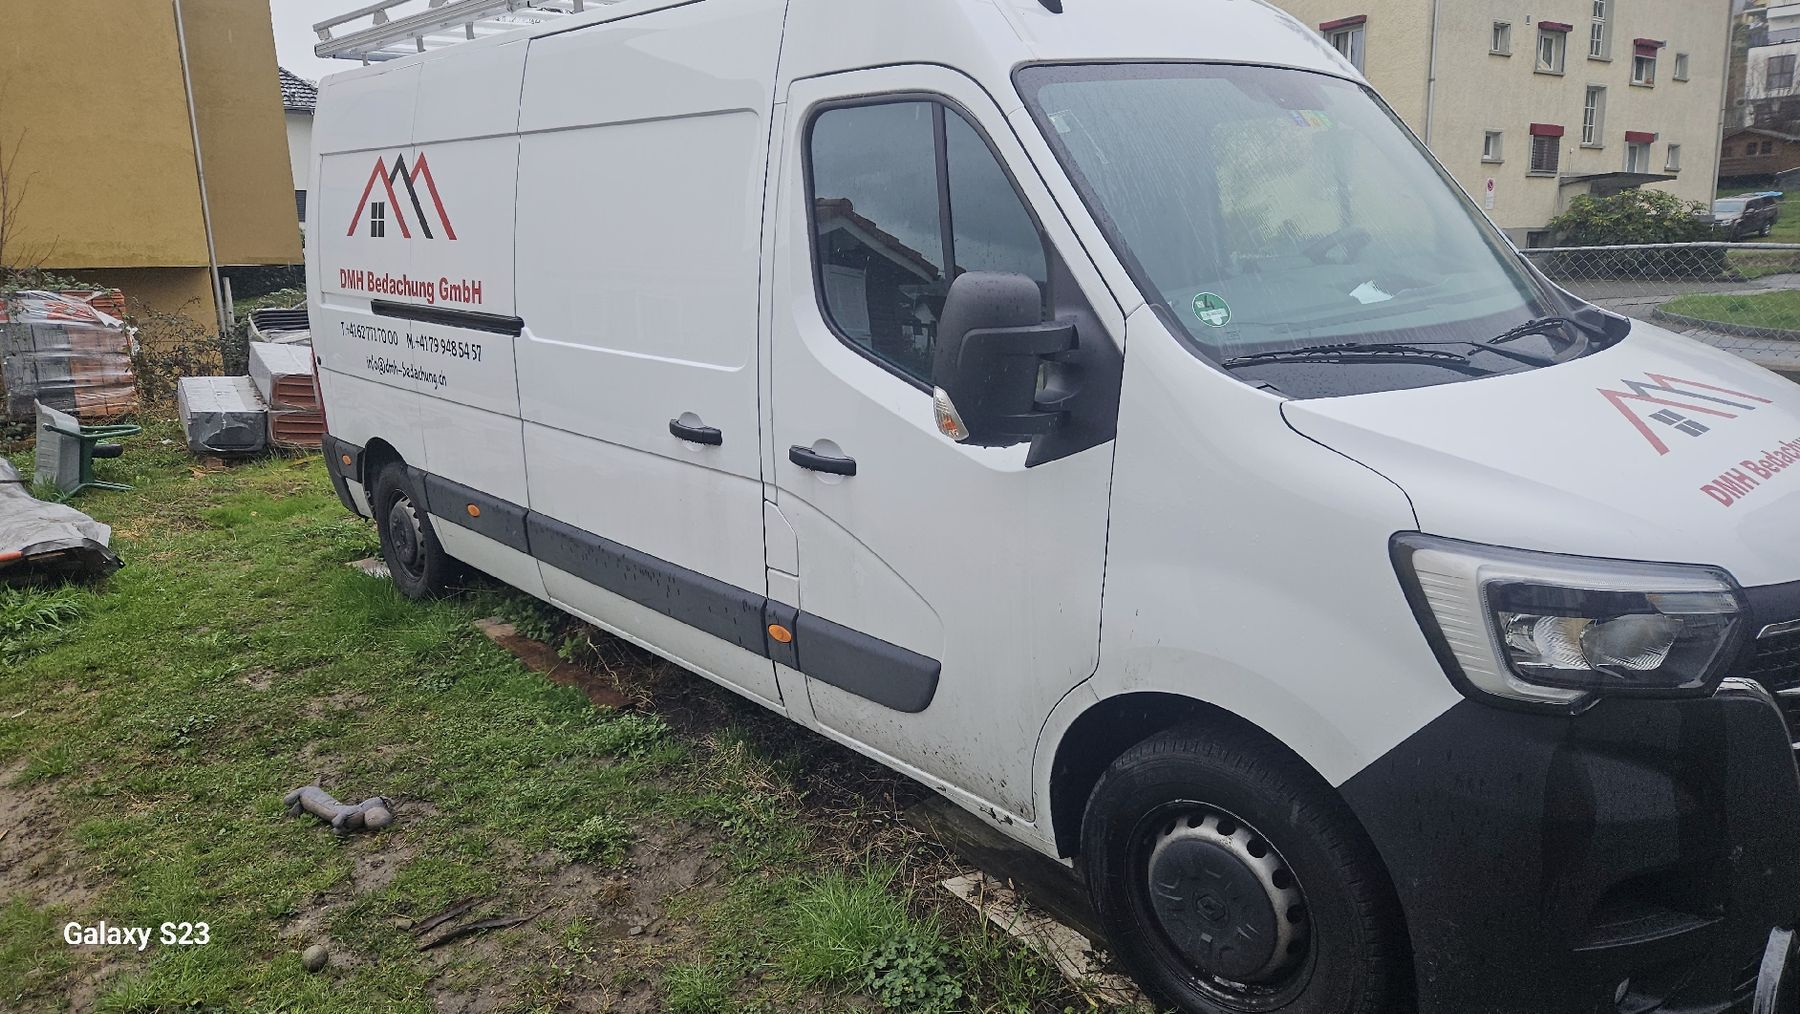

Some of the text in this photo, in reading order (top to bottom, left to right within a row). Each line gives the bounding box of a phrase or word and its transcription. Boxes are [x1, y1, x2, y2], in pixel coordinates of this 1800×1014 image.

[340, 268, 482, 305] DMH Bedachung GmbH
[1699, 467, 1761, 508] DMH
